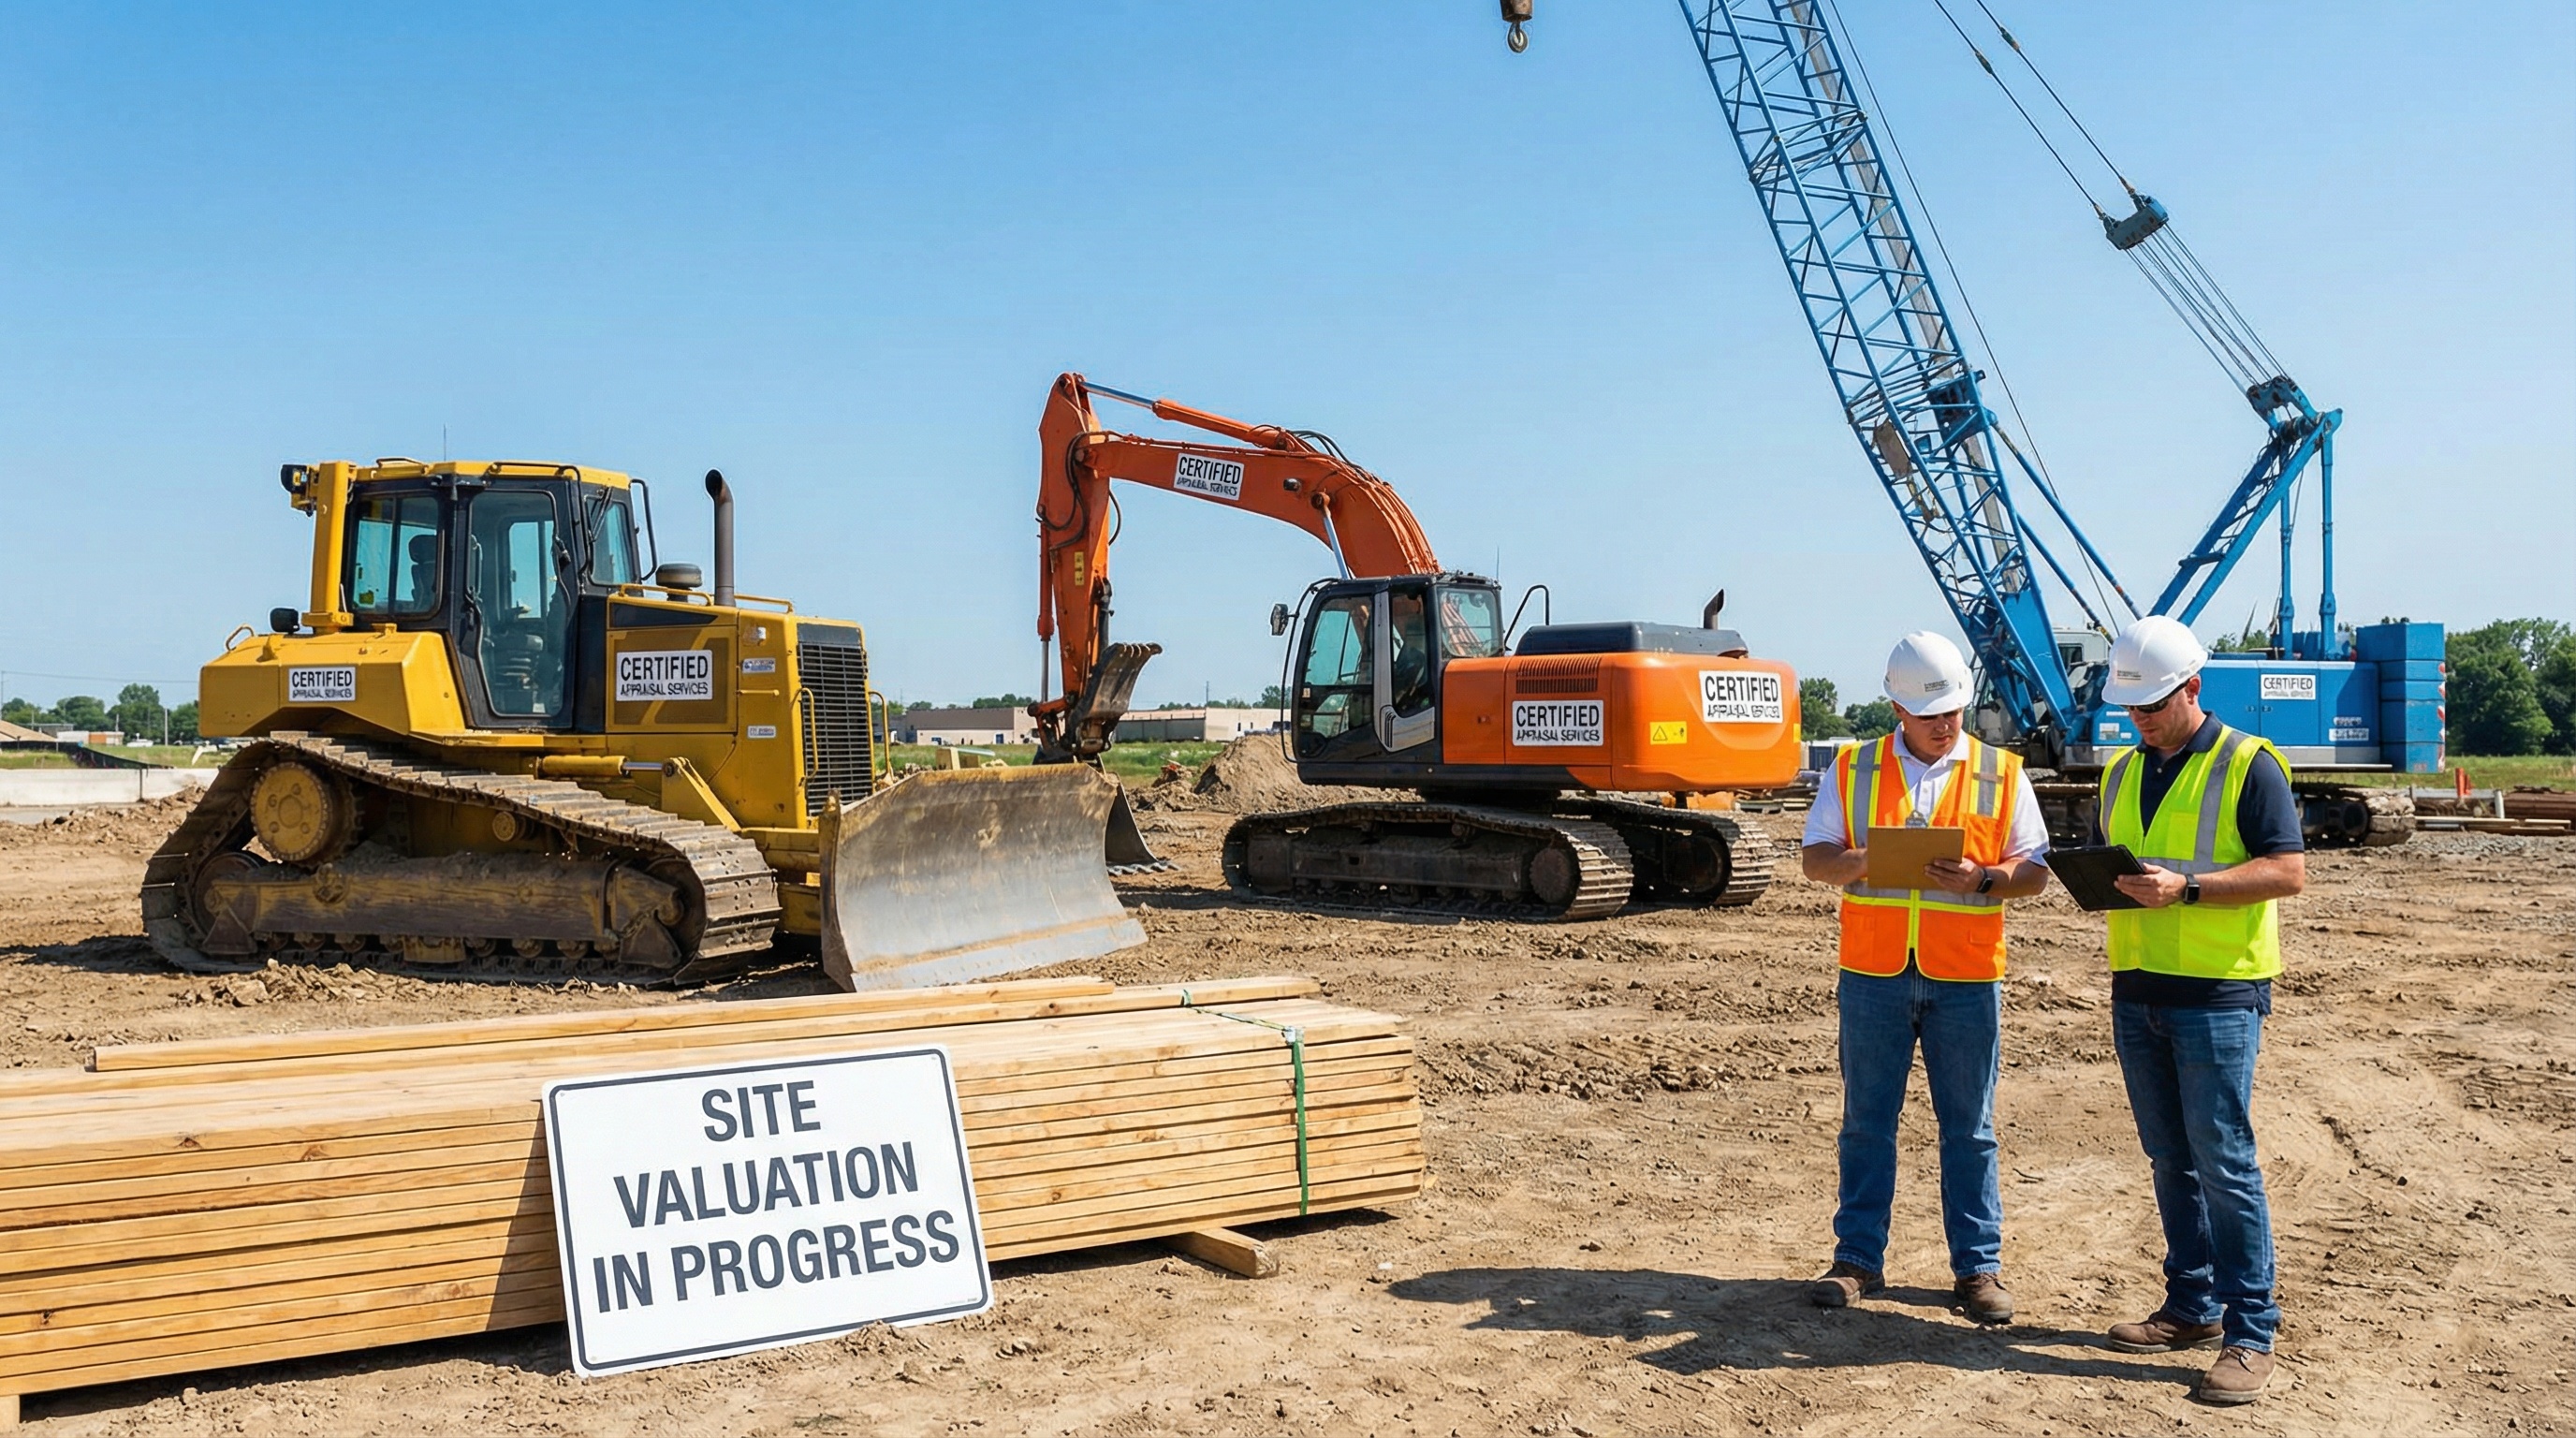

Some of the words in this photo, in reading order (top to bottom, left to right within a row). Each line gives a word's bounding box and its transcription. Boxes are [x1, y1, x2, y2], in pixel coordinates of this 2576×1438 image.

[1178, 456, 1241, 485] CERTIFIED
[291, 670, 353, 688] CERTIFIED
[620, 655, 709, 682] CERTIFIED
[1705, 675, 1778, 702] CERTIFIED
[2262, 677, 2313, 690] CERTIFIED
[1515, 705, 1600, 727] CERTIFIED
[701, 1079, 821, 1142] SITE
[612, 1140, 919, 1229] VALUATION
[593, 1251, 654, 1313] IN
[670, 1210, 959, 1301] PROGRESS
